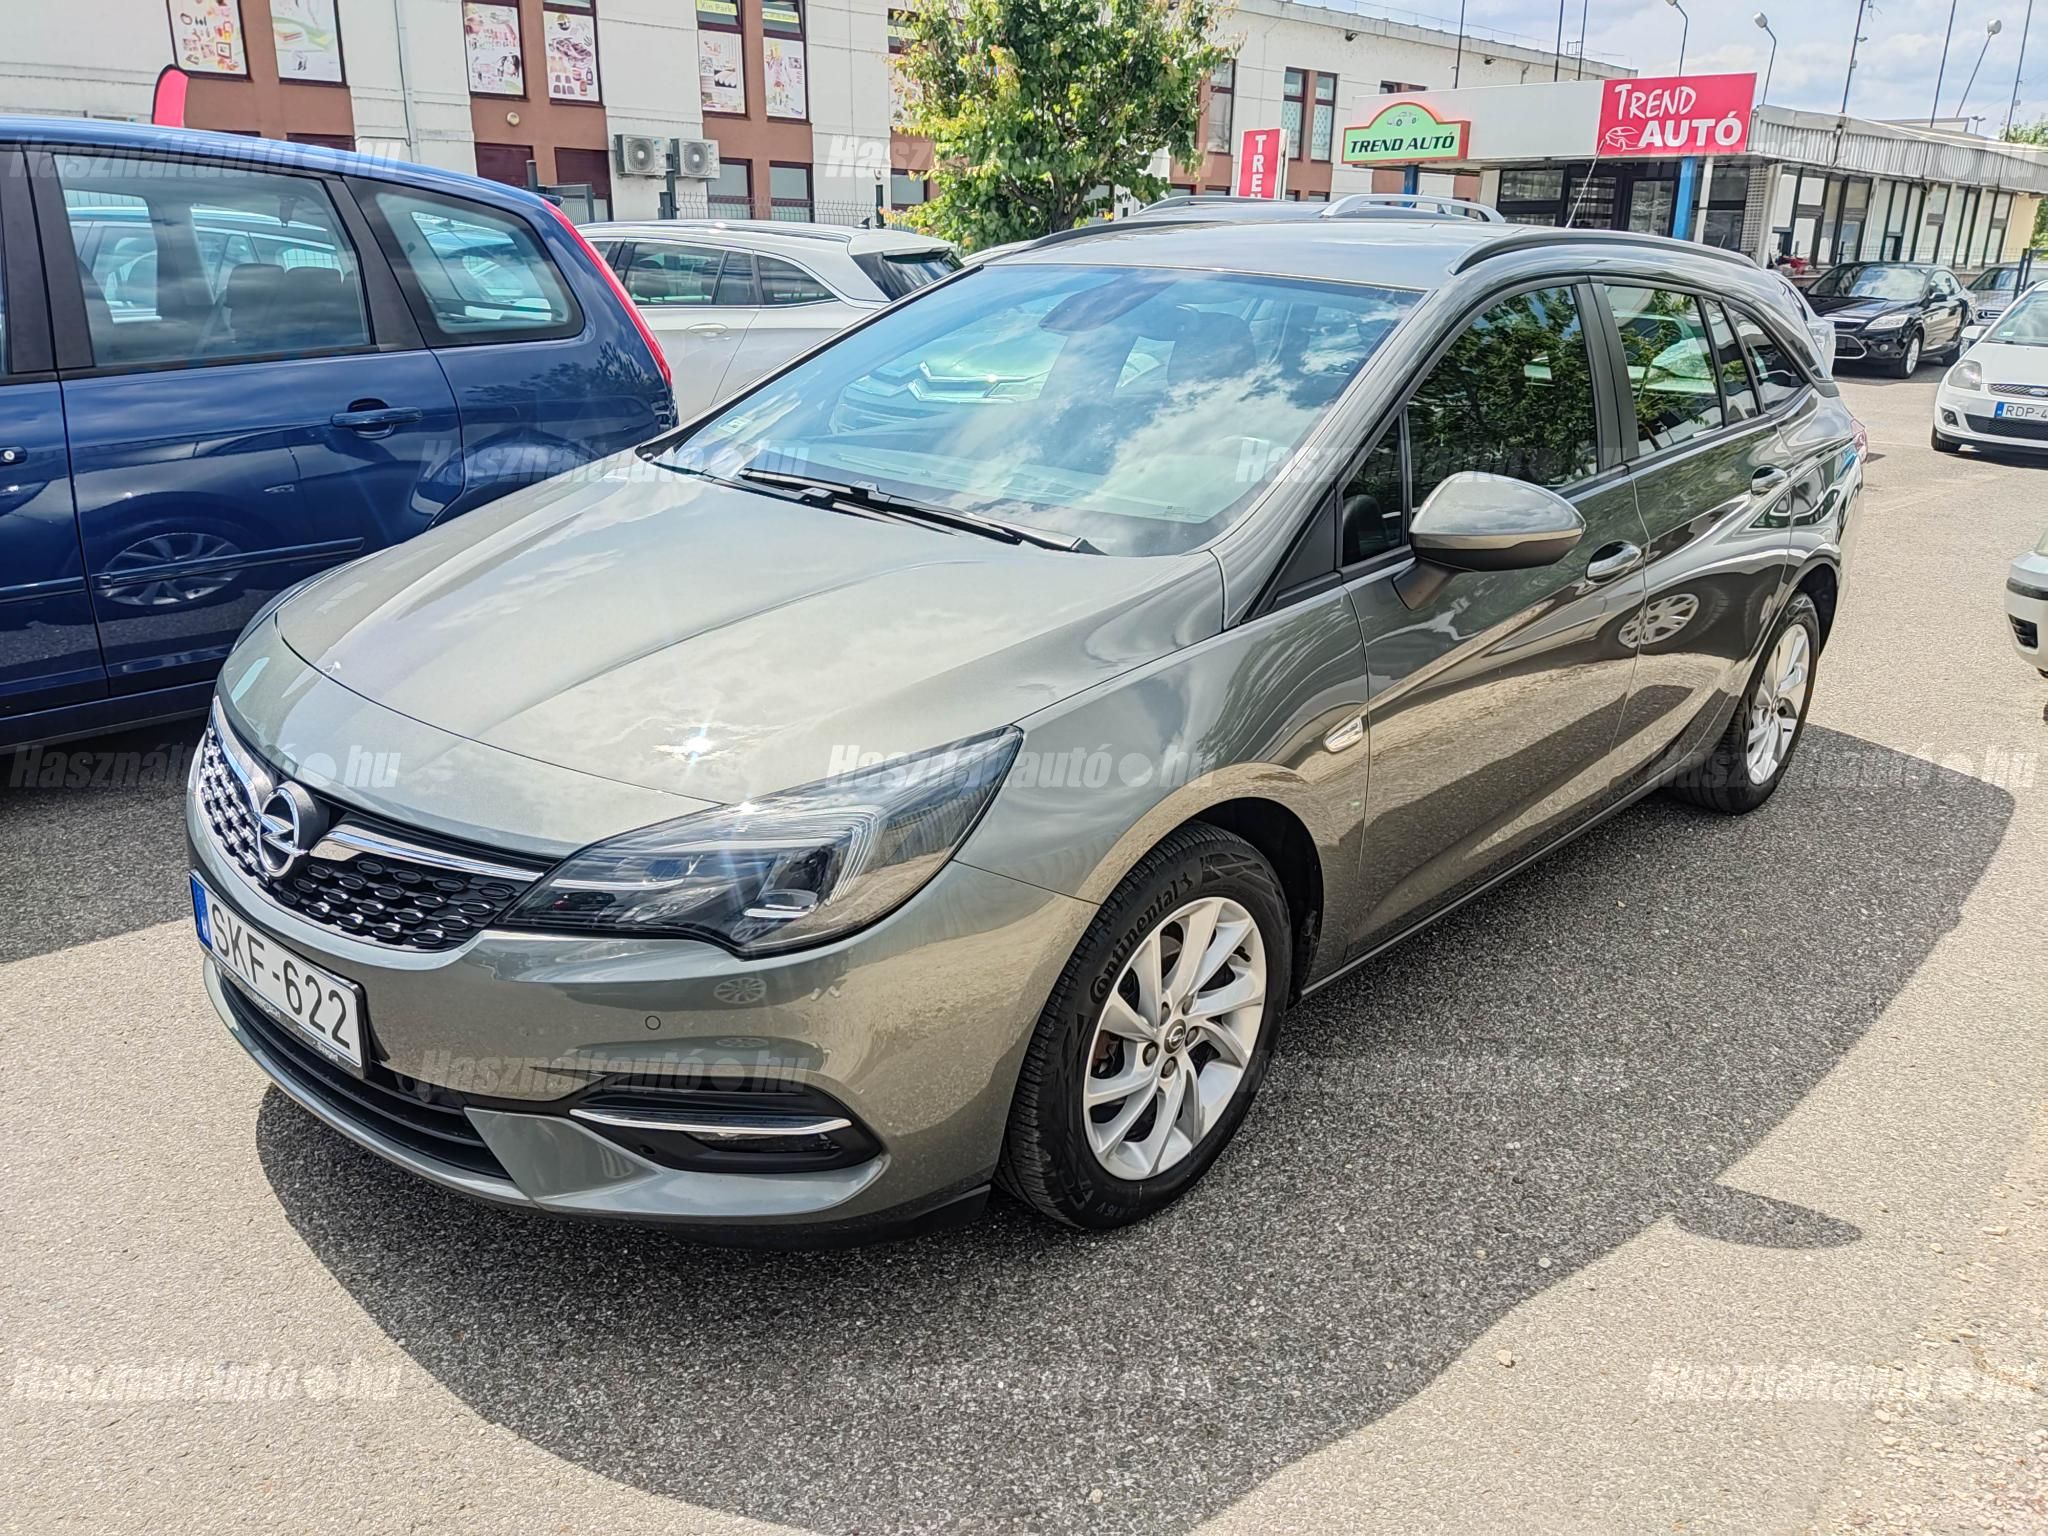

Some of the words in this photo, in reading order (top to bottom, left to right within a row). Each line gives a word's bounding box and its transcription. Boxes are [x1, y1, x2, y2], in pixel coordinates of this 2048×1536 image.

[1614, 83, 1697, 120] TREND
[1350, 138, 1404, 154] TREND
[1405, 131, 1455, 151] AUTÓ
[1637, 111, 1743, 147] AUTÓ
[1090, 880, 1180, 1004] Continental
[211, 903, 350, 1050] SKF-622
